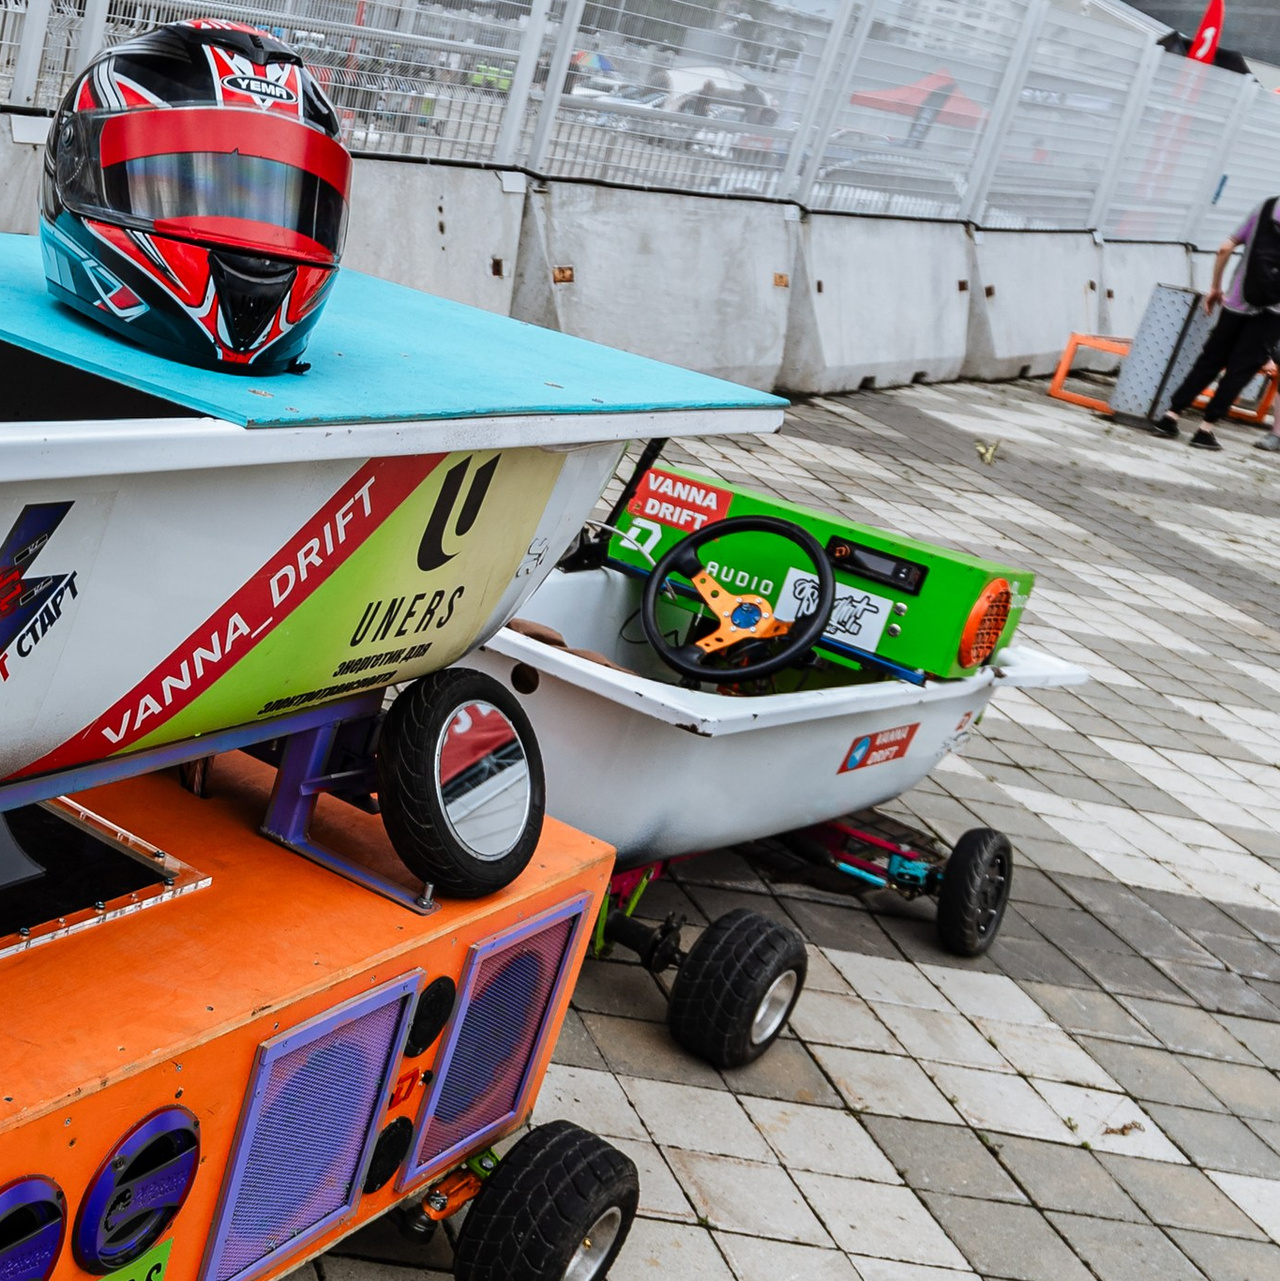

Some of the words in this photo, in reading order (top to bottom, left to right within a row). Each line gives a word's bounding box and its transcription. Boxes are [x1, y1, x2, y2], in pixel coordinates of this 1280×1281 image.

[236, 77, 288, 100] YEMA
[647, 472, 718, 510] VANNA
[644, 498, 708, 531] DRIFT
[705, 560, 775, 596] AUDIO
[15, 570, 78, 658] СТАРТ
[349, 585, 466, 648] UNERS
